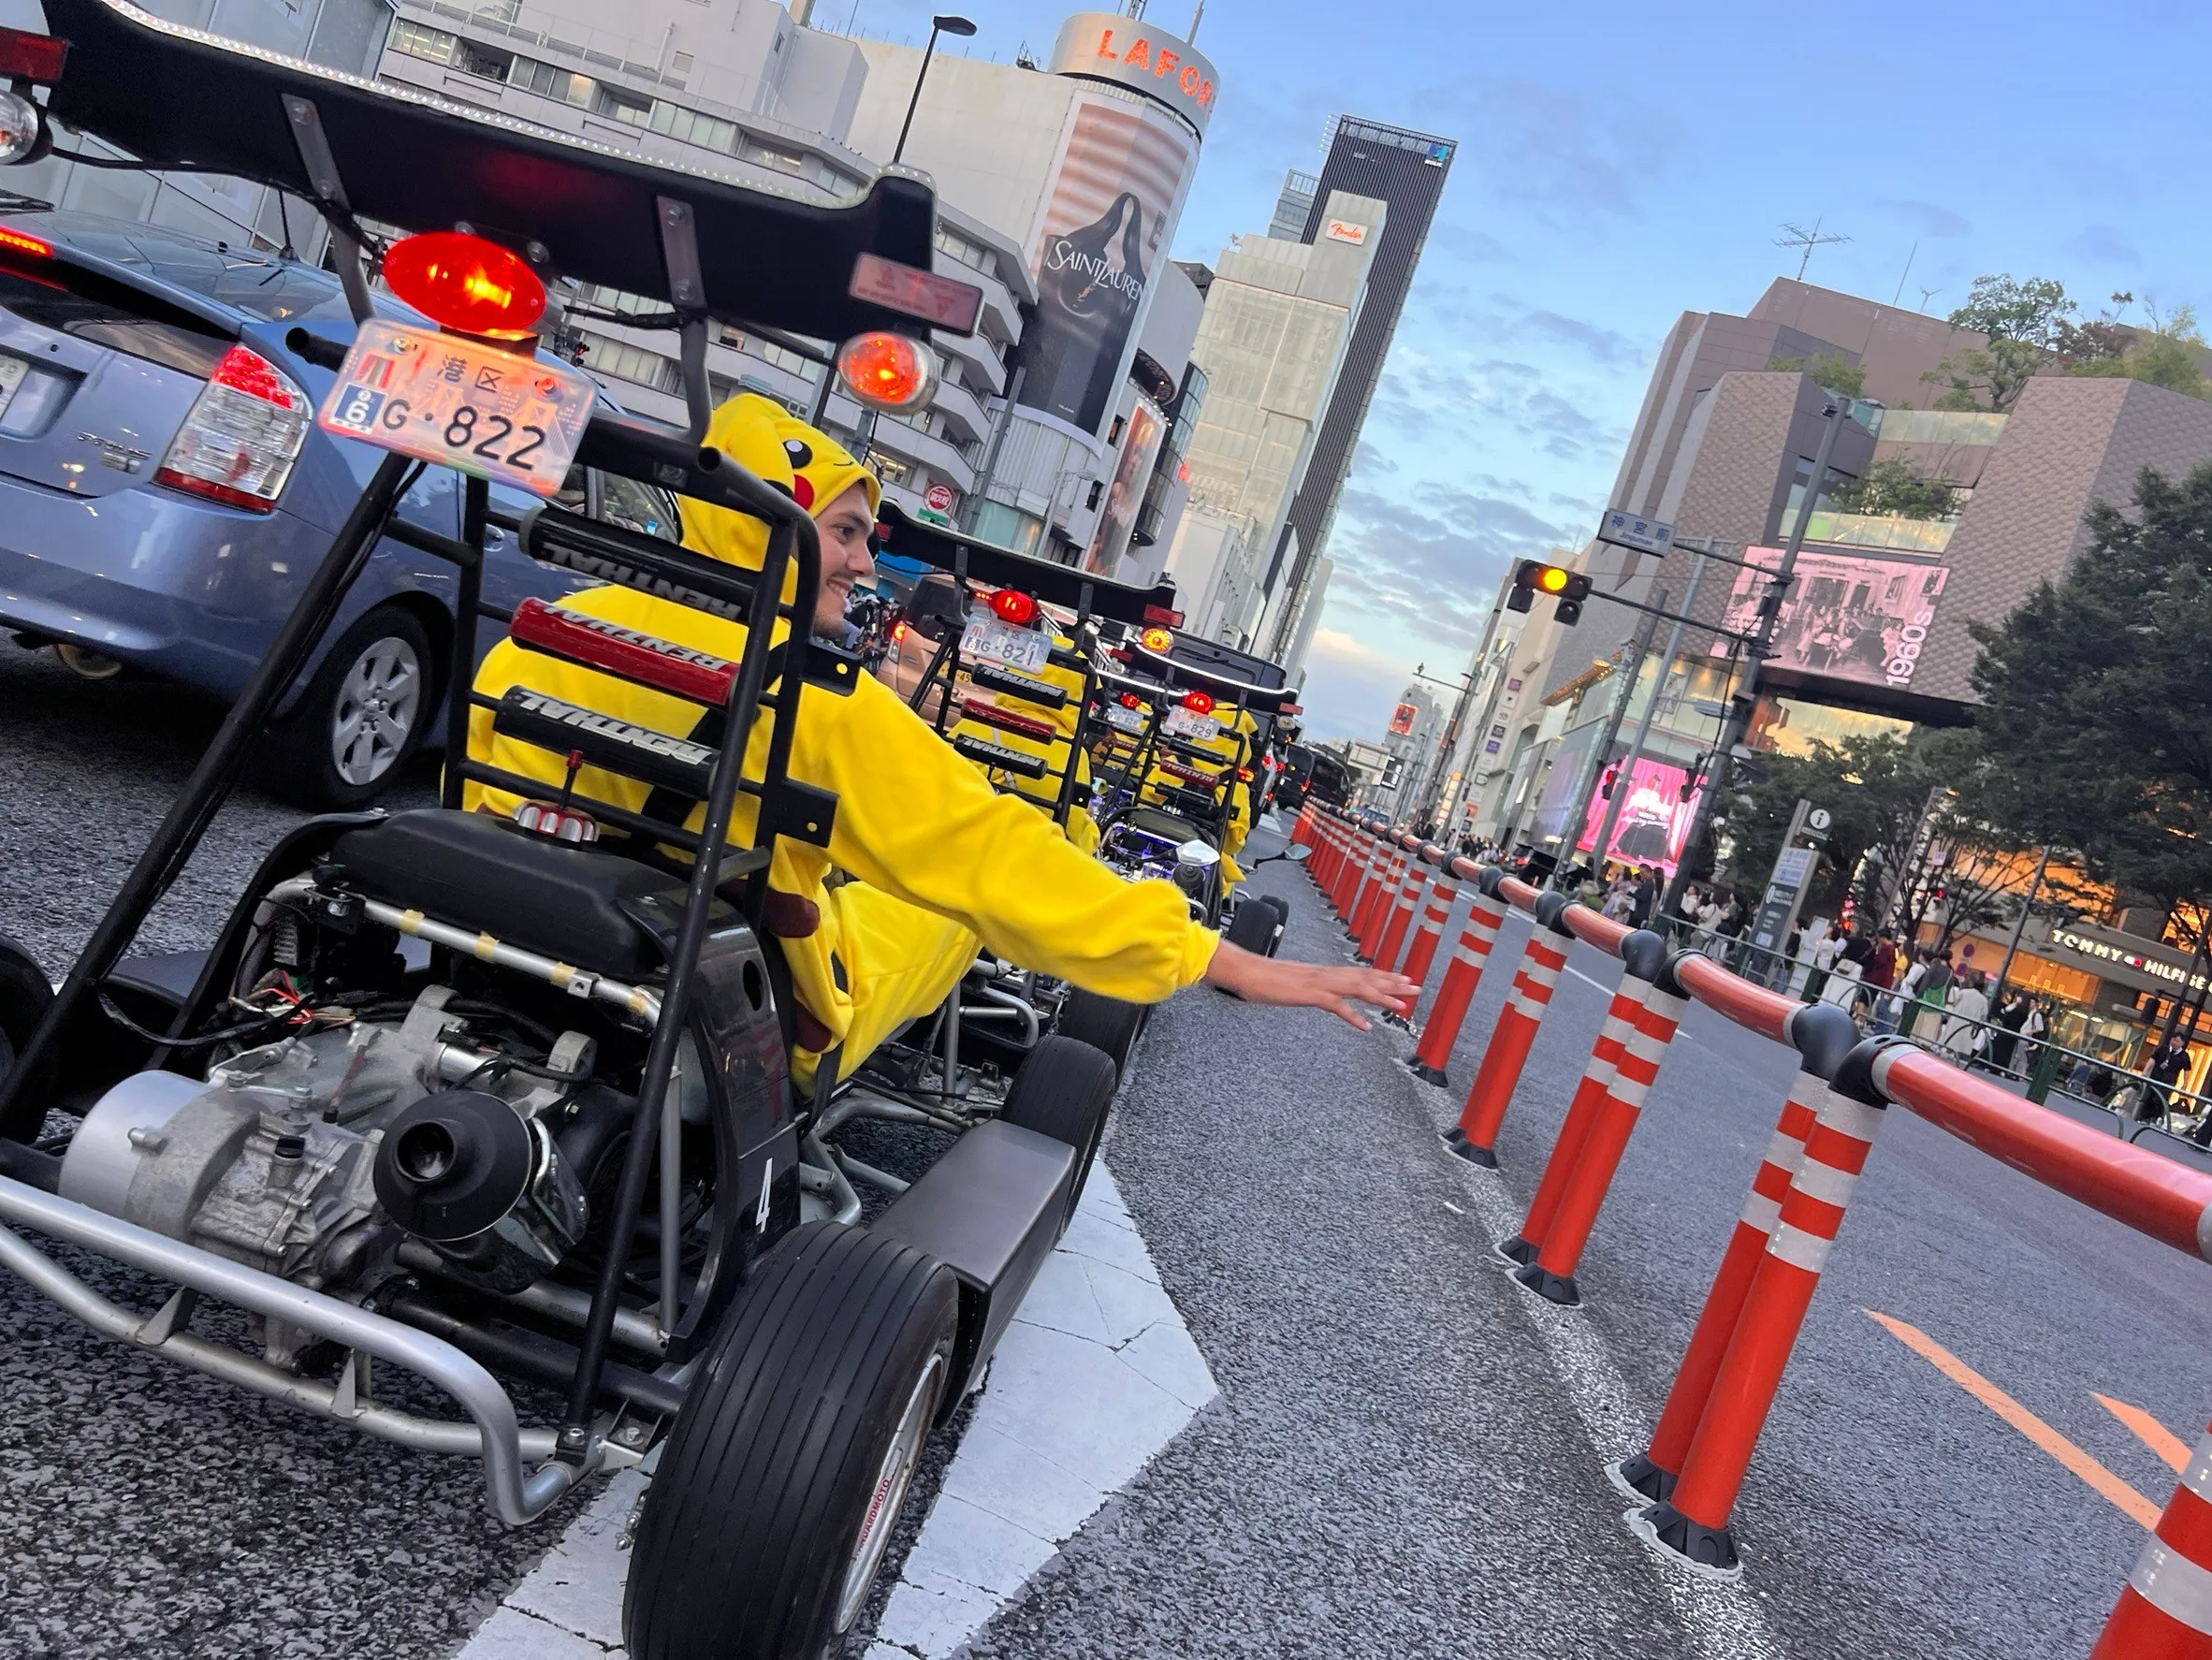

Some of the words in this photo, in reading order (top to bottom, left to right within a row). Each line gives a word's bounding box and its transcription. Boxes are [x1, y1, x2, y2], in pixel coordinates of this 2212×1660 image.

[1331, 223, 1362, 240] Fender
[437, 354, 504, 393] 港区
[1611, 516, 1670, 541] 神宮前
[541, 541, 742, 619] RENTHAL
[545, 604, 731, 672] RENTHAL
[1885, 611, 1932, 686] 1960s
[519, 691, 712, 765] RENTHAL
[962, 736, 1043, 766] RENTHAL
[2052, 929, 2122, 962] TOMMY
[755, 1157, 773, 1233] 4
